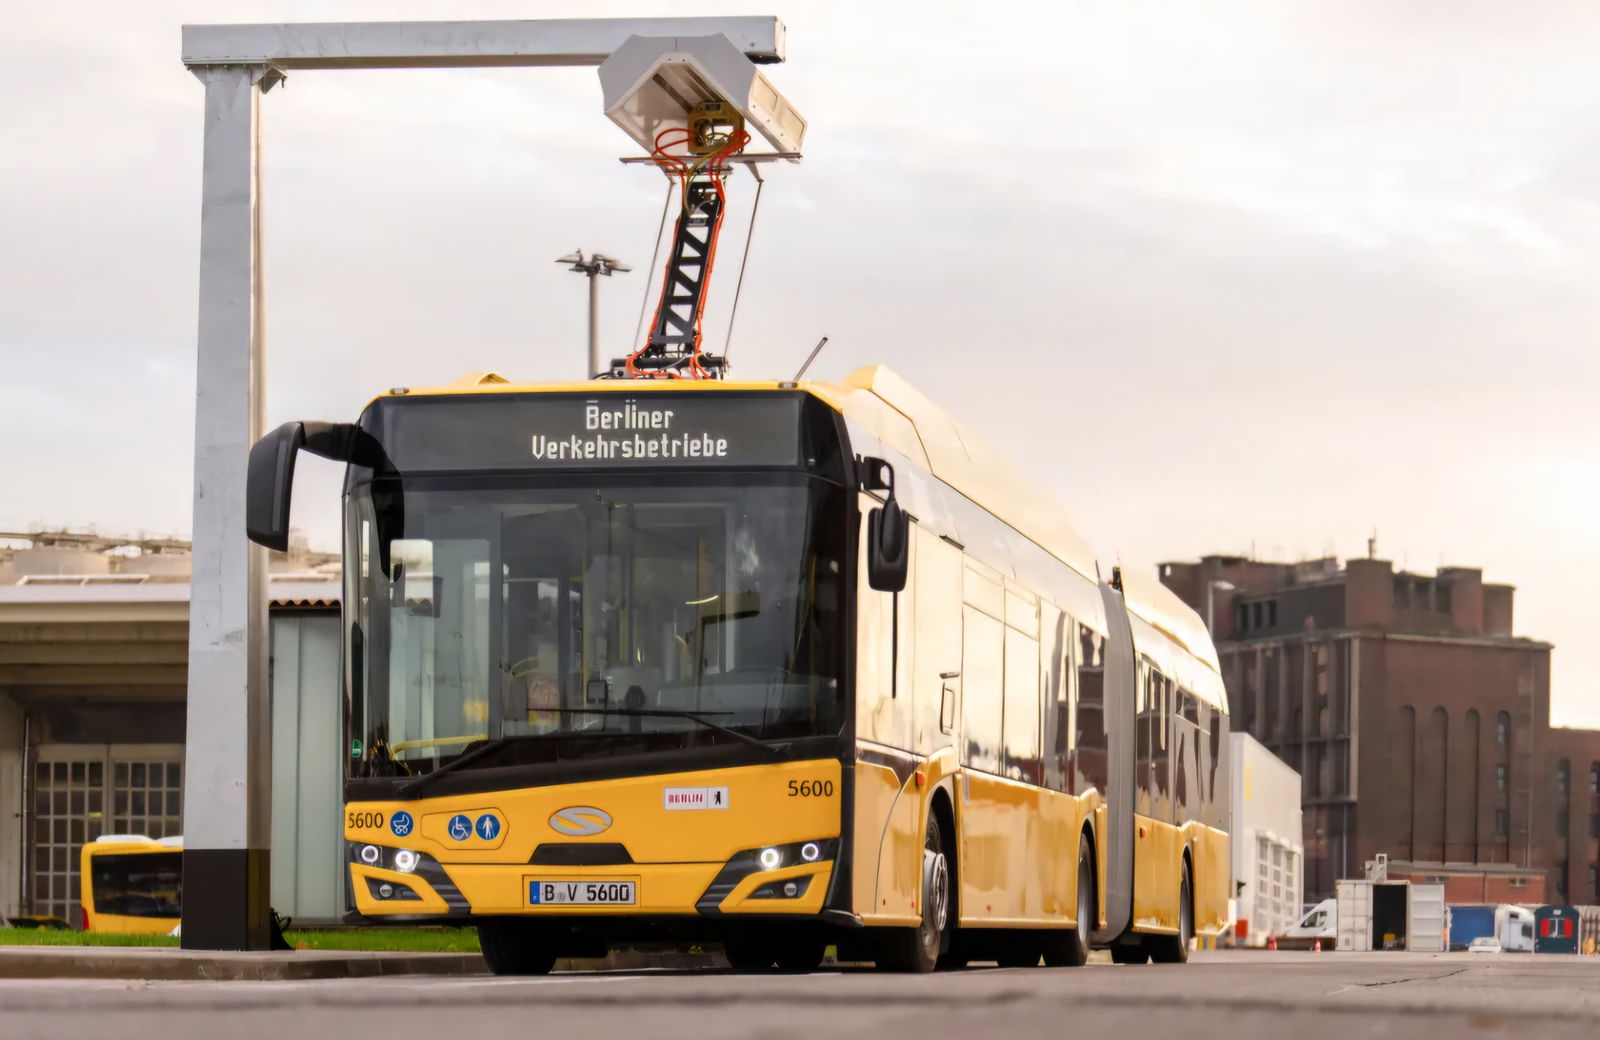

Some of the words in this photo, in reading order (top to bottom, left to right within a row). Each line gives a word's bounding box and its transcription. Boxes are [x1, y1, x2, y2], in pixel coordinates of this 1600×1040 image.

[586, 401, 674, 429] Berliner
[532, 433, 728, 459] Verkehrsbetriebe
[788, 780, 834, 797] 5600
[348, 812, 384, 828] 5600
[544, 884, 555, 901] B
[567, 884, 577, 901] V
[586, 884, 630, 901] 5600
